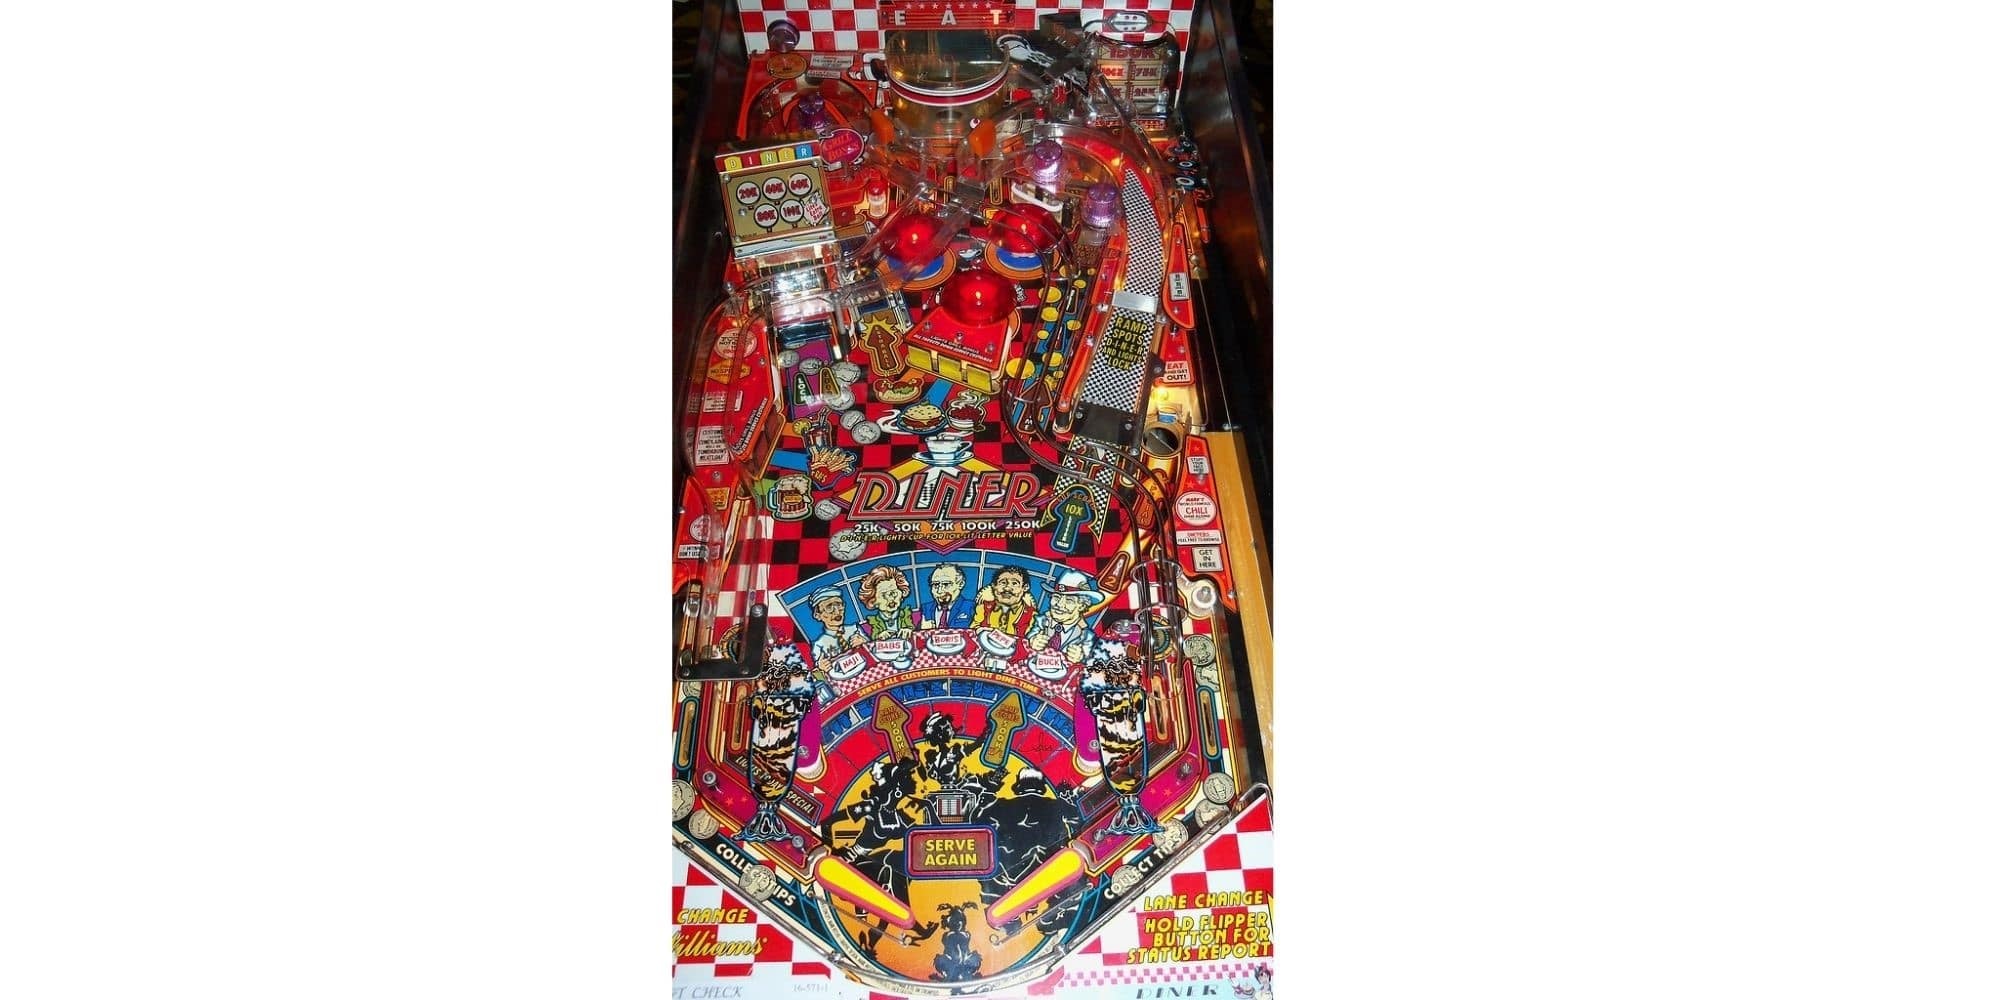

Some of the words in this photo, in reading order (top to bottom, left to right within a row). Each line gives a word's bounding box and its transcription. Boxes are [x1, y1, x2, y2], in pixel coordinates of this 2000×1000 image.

[738, 187, 758, 199] 20K
[1116, 317, 1148, 334] RAMP
[1113, 328, 1144, 345] SPOTS
[1102, 347, 1116, 356] AND
[1118, 350, 1142, 363] LIGHTS
[1107, 356, 1131, 370] LOCK
[1167, 362, 1184, 370] EAT
[848, 471, 1042, 521] DINER
[1065, 503, 1084, 516] 10X
[1185, 507, 1208, 515] CHILI
[854, 524, 879, 534] 25K
[894, 523, 921, 532] 50K
[931, 522, 956, 532] 75K
[962, 522, 997, 531] 100K
[1005, 520, 1041, 530] 250K
[879, 534, 906, 542] LIGHTS
[1008, 531, 1033, 539] VALUE
[1104, 576, 1117, 588] 2
[934, 635, 960, 644] BORIS
[842, 655, 859, 669] HAJI
[1038, 658, 1060, 666] BUCK
[857, 683, 883, 697] SERVE
[884, 676, 898, 686] ALL
[901, 669, 950, 682] CUSTOMERS
[967, 669, 993, 679] LIGHT
[995, 675, 1039, 694] DINE-TIME
[785, 790, 815, 814] SPECIAL
[925, 839, 976, 852] SERVE
[924, 853, 978, 866] AGAIN
[1104, 855, 1154, 899] COLLECT
[1153, 836, 1182, 859] TIPS
[767, 879, 797, 907] TIPS
[1144, 894, 1188, 911] LANE
[1194, 890, 1264, 909] CHANGE
[677, 907, 750, 924] CHANGE
[1145, 915, 1195, 933] HOLD
[1199, 911, 1269, 931] FLIPPER
[1153, 928, 1227, 947] BUTTON
[1233, 926, 1270, 943] FOR
[1127, 944, 1192, 965] STATUS
[1197, 941, 1271, 961] REPORT
[692, 986, 744, 999] CHECK
[1136, 984, 1220, 1000] DINER
